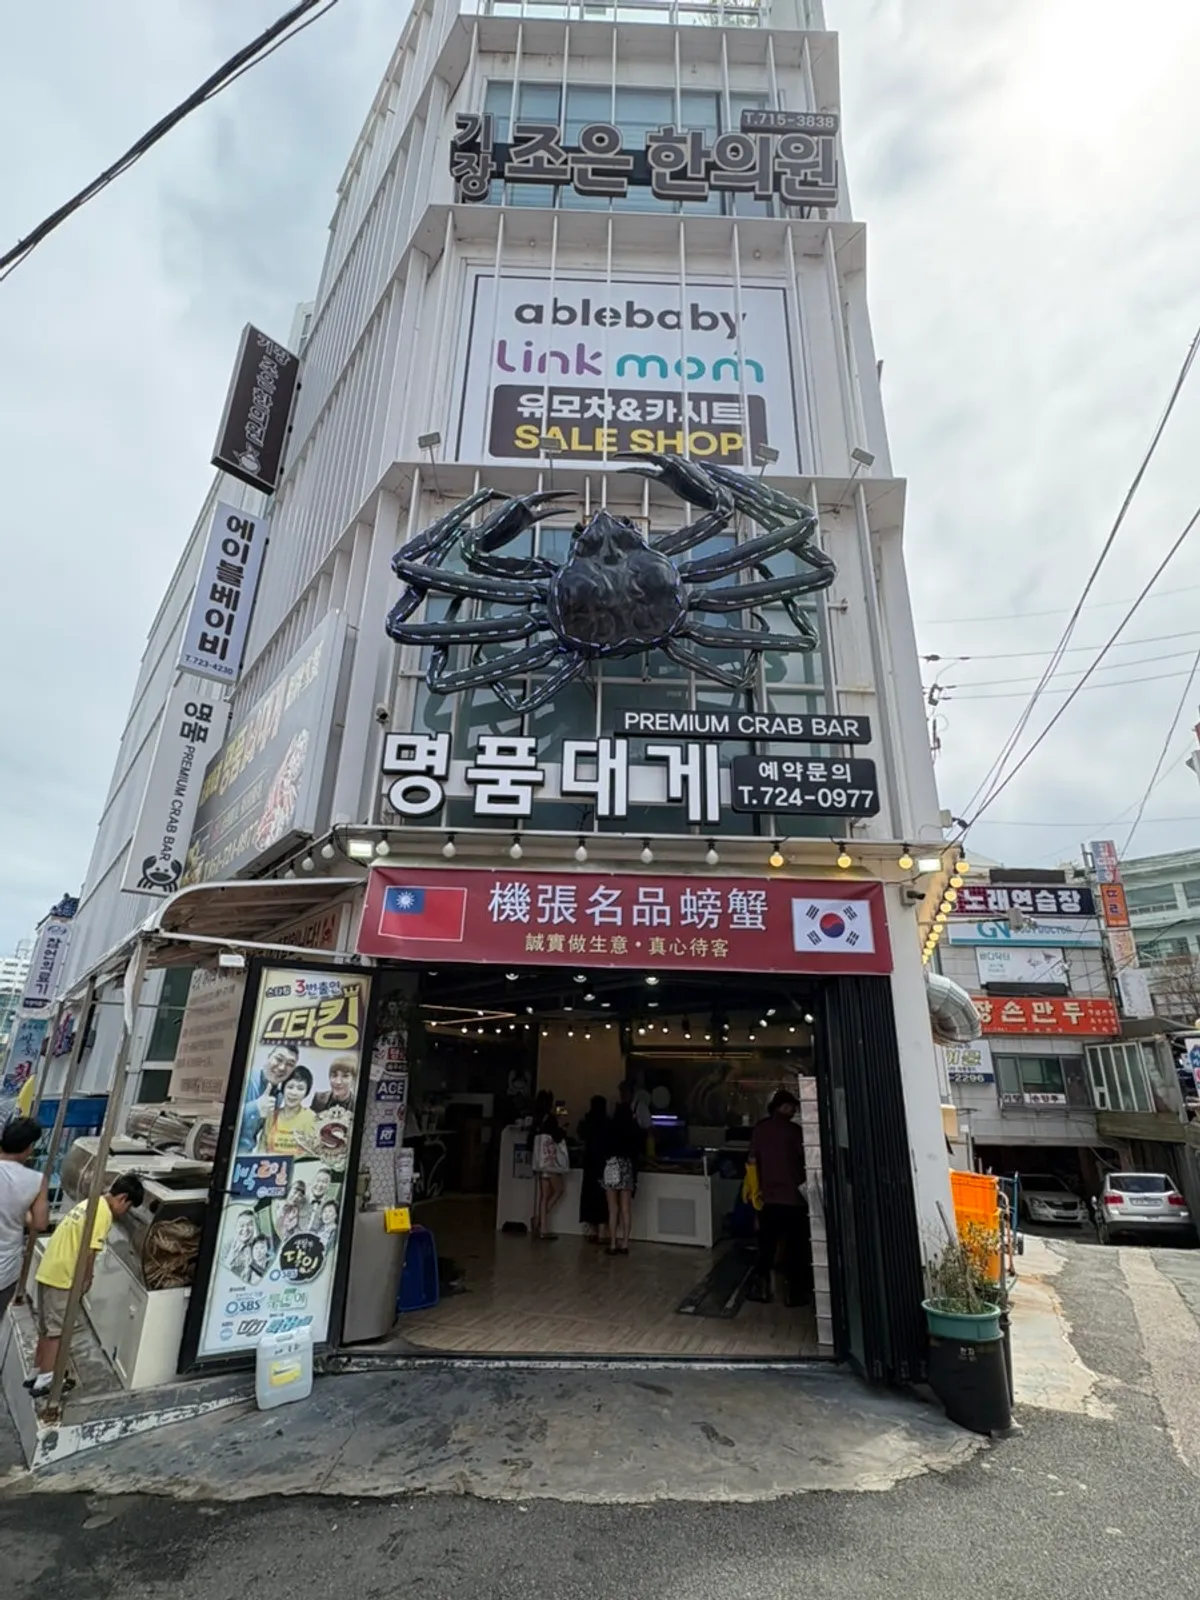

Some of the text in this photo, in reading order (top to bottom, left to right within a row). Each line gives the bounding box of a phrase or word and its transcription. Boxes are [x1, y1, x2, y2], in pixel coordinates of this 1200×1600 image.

[742, 110, 836, 130] T.715-3838
[451, 113, 497, 203] 기장
[514, 297, 748, 340] ablebaby
[615, 351, 765, 384] mom
[517, 393, 748, 425] 유모차&카시트
[514, 424, 746, 457] SALE SHOP
[198, 514, 255, 662] 에이블베이비
[184, 654, 234, 675] T.723-4230
[179, 702, 213, 744] 명품
[624, 711, 861, 738] PREMIUM CRAB BAR
[382, 732, 721, 825] 명품대게
[757, 760, 853, 784] 예약문의
[158, 744, 196, 862] PREMIUM CRAB BAR
[737, 786, 875, 810] T.724-0977
[487, 881, 769, 932] 機張名品螃蟹
[963, 888, 1082, 913] 노래연습장
[263, 984, 360, 1049] 스타킹
[239, 1300, 261, 1312] SBS
